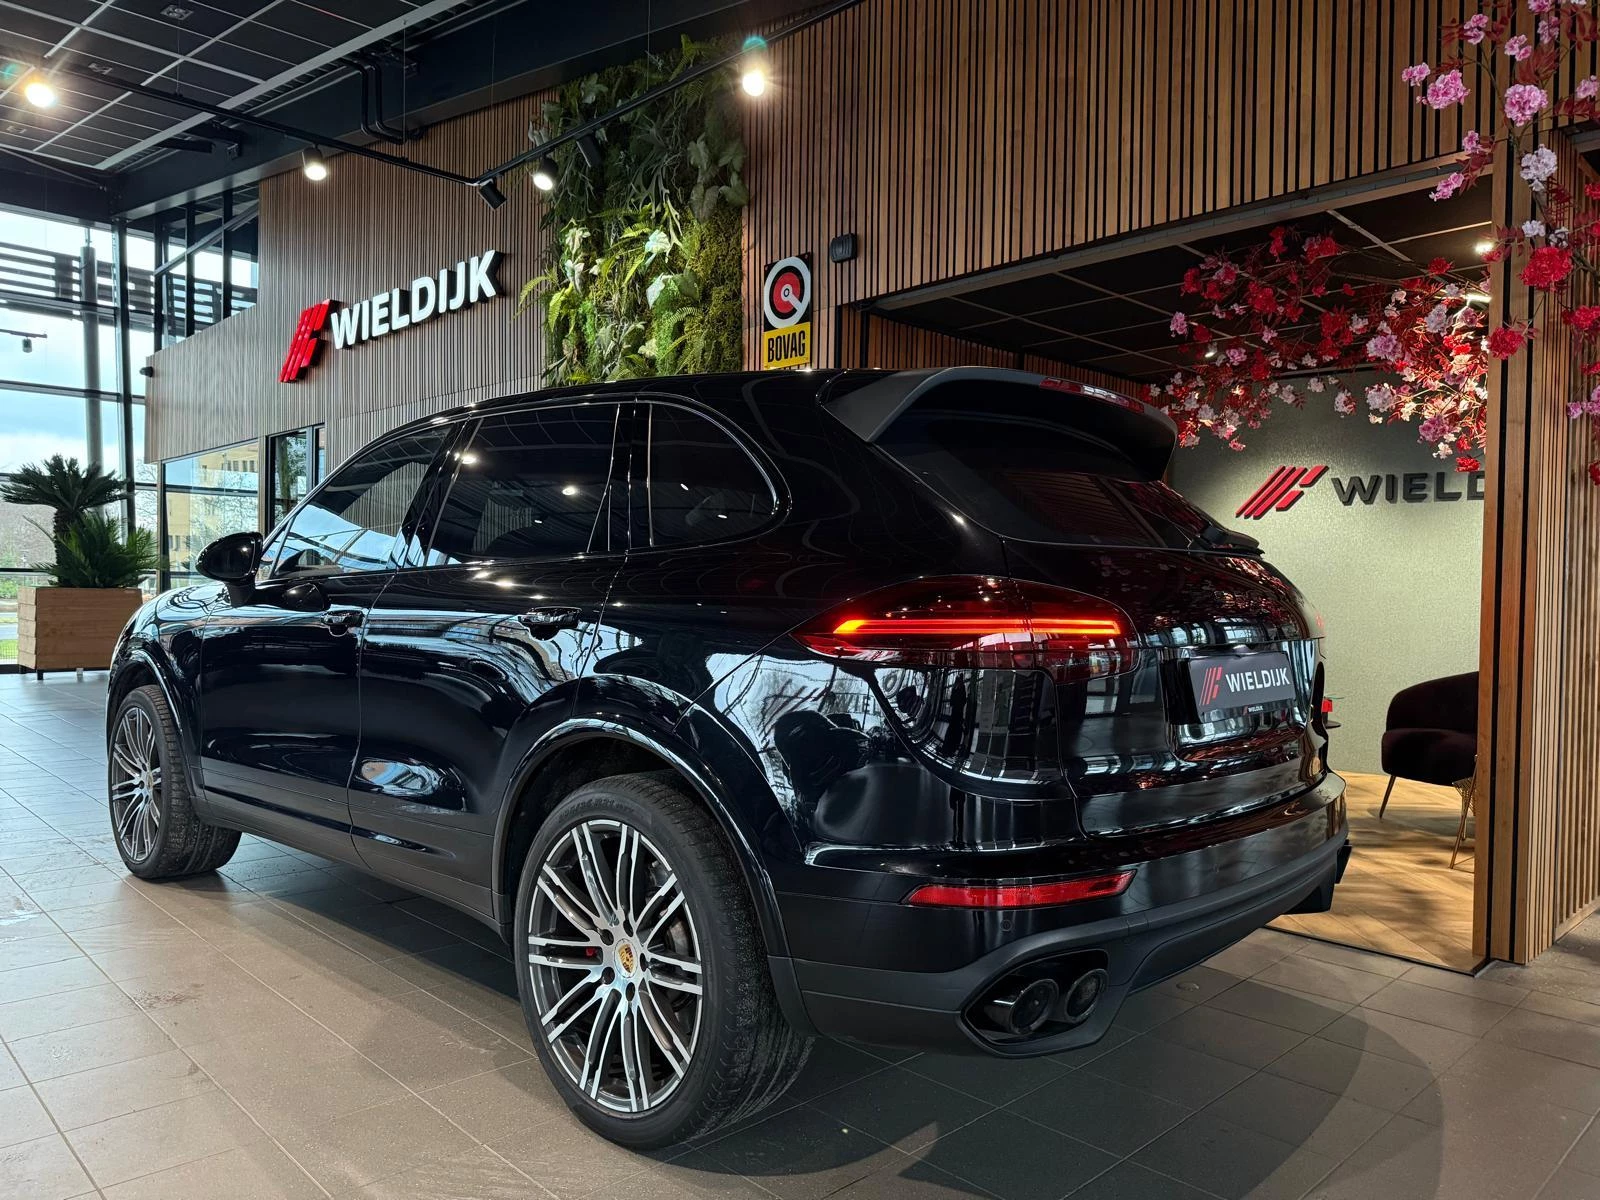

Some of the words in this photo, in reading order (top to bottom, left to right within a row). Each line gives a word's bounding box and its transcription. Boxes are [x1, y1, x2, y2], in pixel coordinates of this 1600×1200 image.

[331, 250, 497, 350] WIELDIJK
[767, 330, 806, 363] BOVAG
[1225, 667, 1291, 693] WIELDIJK
